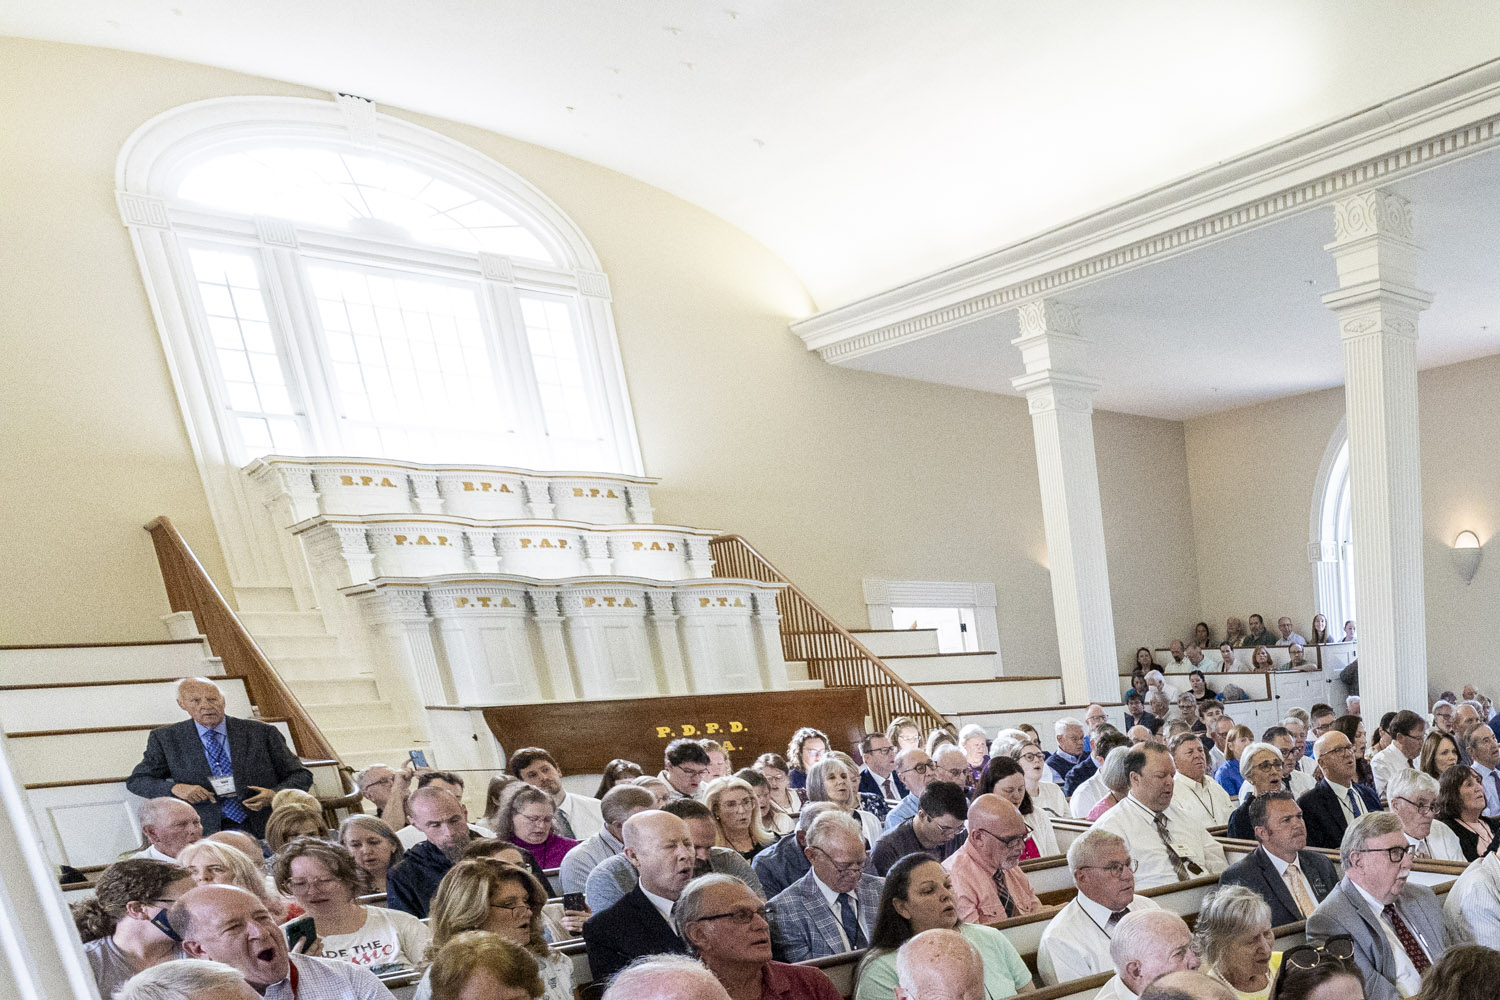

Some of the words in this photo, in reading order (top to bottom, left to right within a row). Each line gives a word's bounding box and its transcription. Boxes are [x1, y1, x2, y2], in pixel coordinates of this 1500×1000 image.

[394, 534, 453, 547] P.A.P.
[520, 538, 572, 549] P.A.P.
[632, 541, 678, 552] P.A.P.
[455, 596, 516, 608] P.T.A.
[583, 596, 637, 608] P.T.A.
[699, 597, 746, 608] P.T.A.
[352, 940, 382, 954] THE
